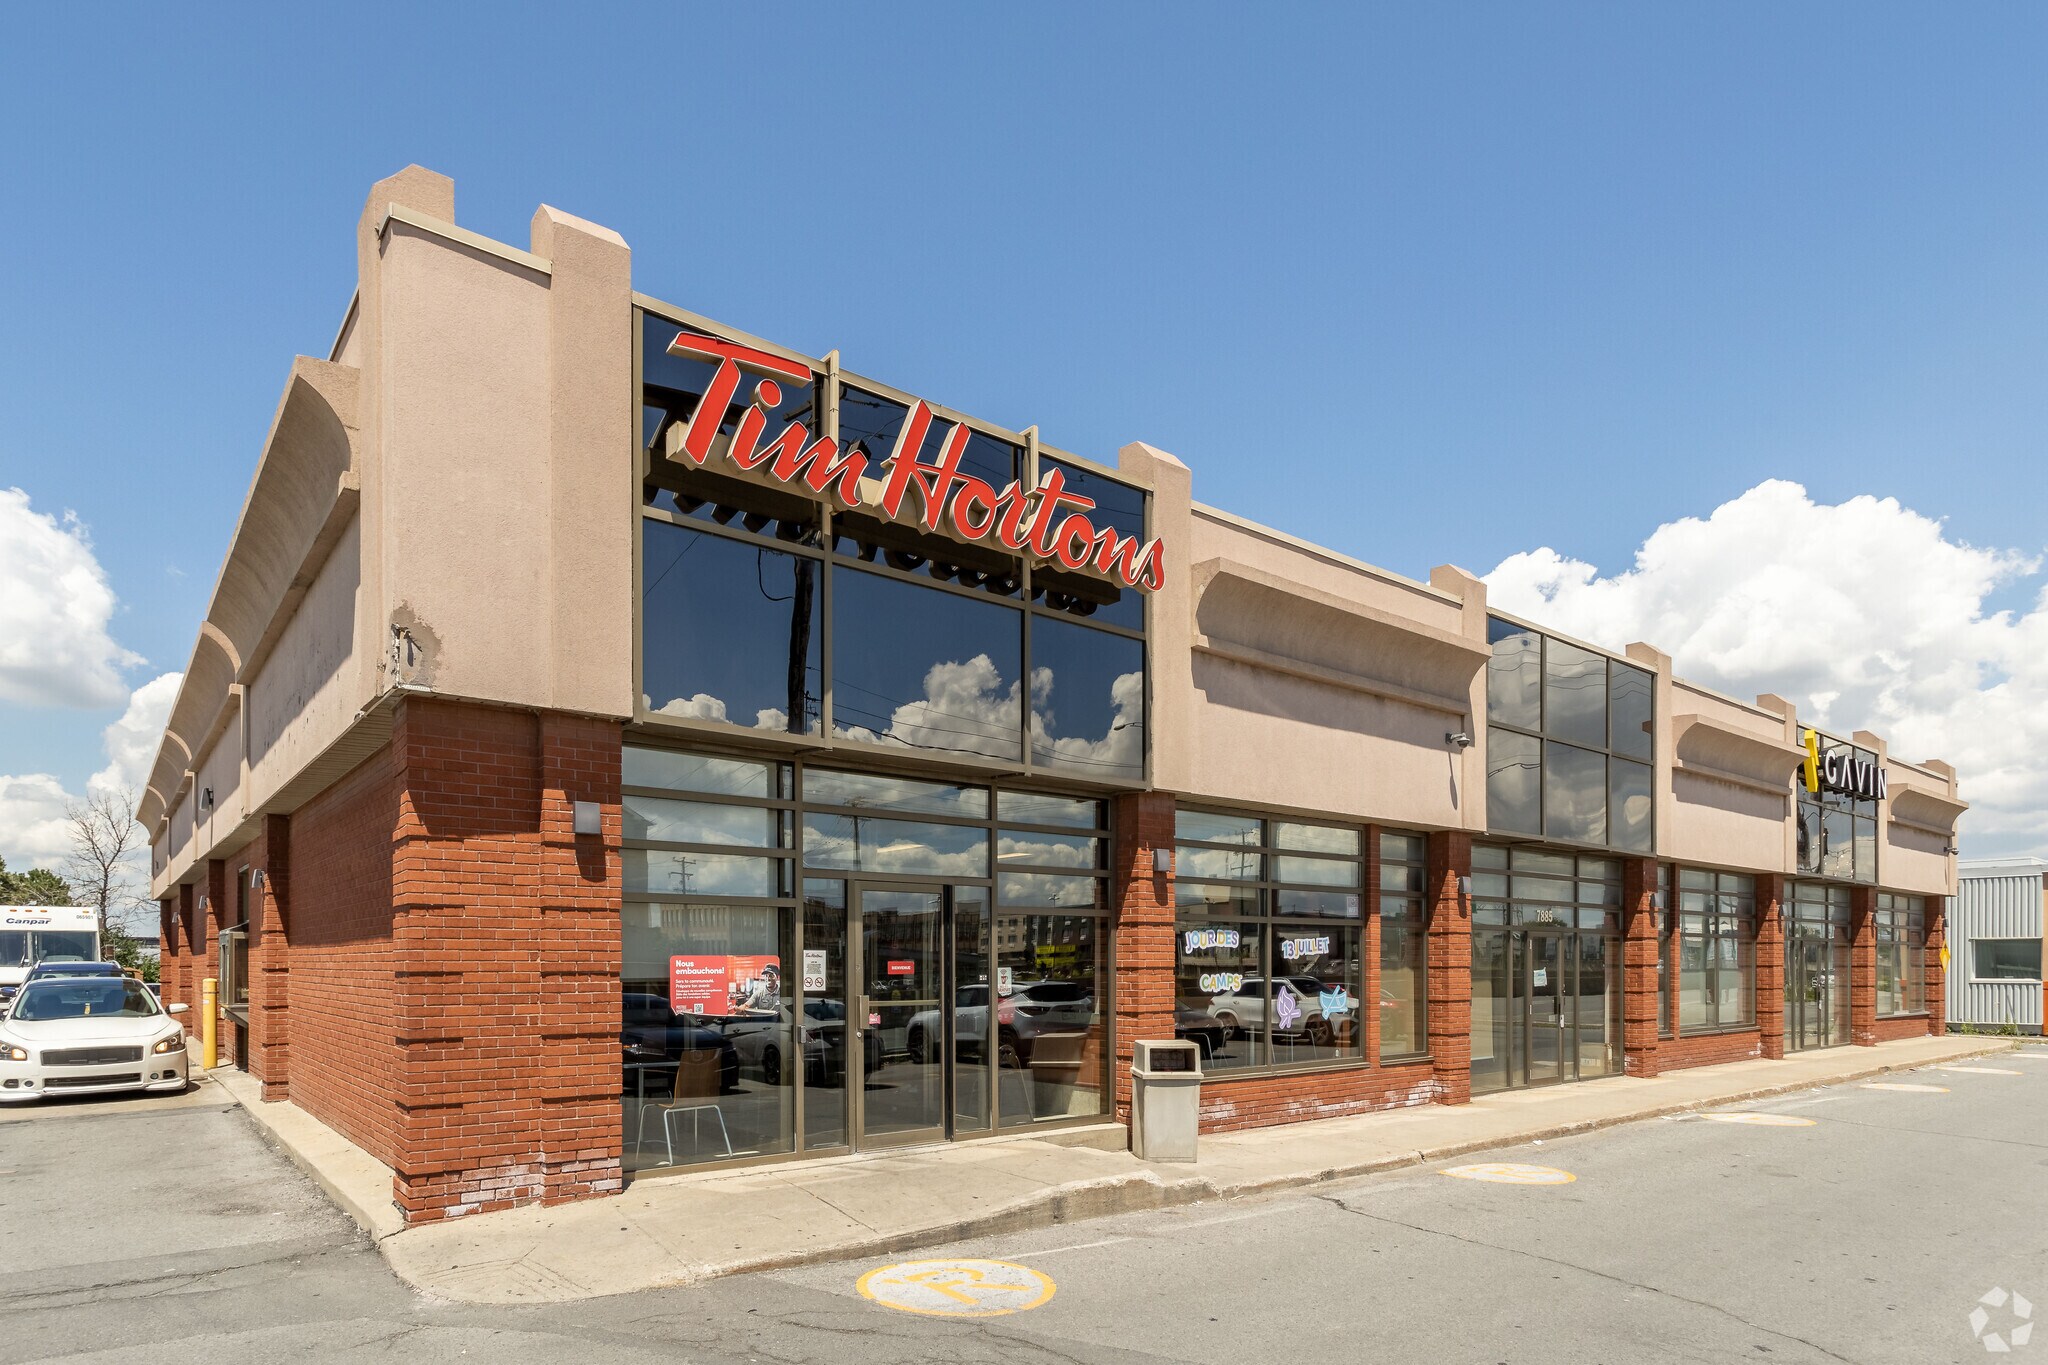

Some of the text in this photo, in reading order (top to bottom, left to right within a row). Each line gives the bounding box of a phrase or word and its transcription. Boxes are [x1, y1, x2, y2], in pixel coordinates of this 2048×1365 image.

[667, 331, 1166, 593] Tim Hortons
[1824, 749, 1887, 800] GAVIN
[1537, 910, 1553, 922] 7885
[1186, 930, 1239, 953] JOUR DES
[1283, 937, 1329, 958] 13 JUILLET
[675, 967, 725, 975] embauchons!
[1201, 974, 1241, 991] CAMPS
